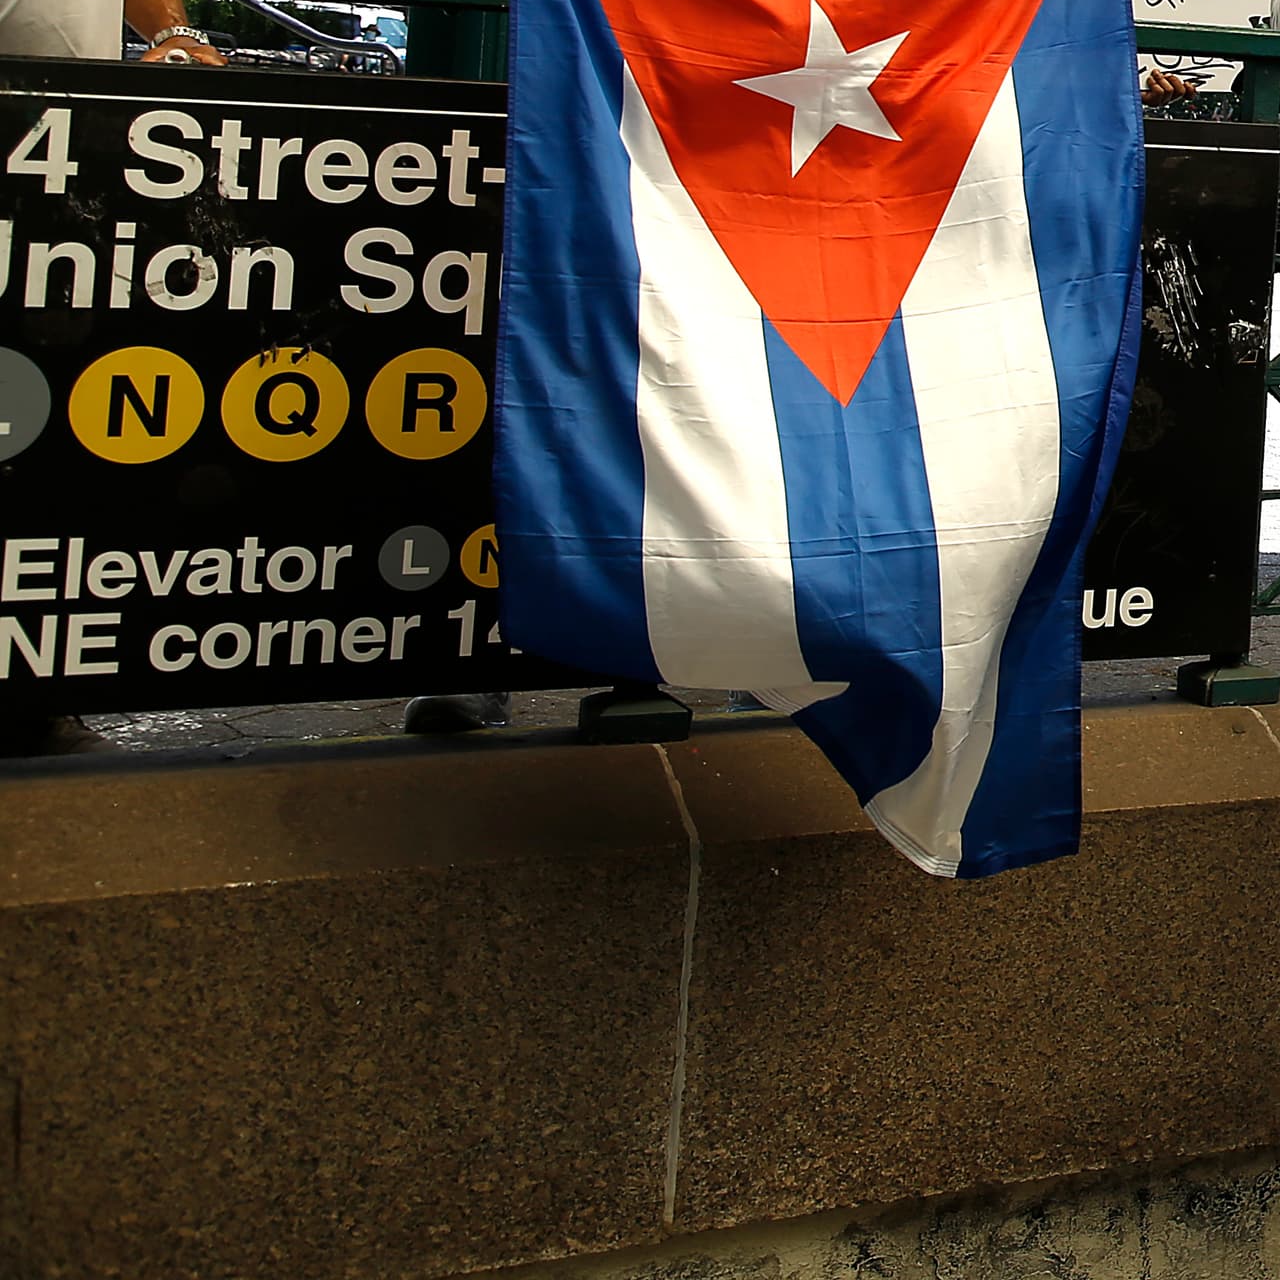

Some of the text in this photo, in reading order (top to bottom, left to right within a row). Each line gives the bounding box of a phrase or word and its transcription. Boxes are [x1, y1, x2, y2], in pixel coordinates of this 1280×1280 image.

[340, 227, 503, 337] Sq
[105, 372, 459, 439] N Q R
[2, 536, 353, 601] Elevator
[401, 539, 430, 575] L
[0, 613, 121, 679] NE
[149, 613, 421, 670] corner
